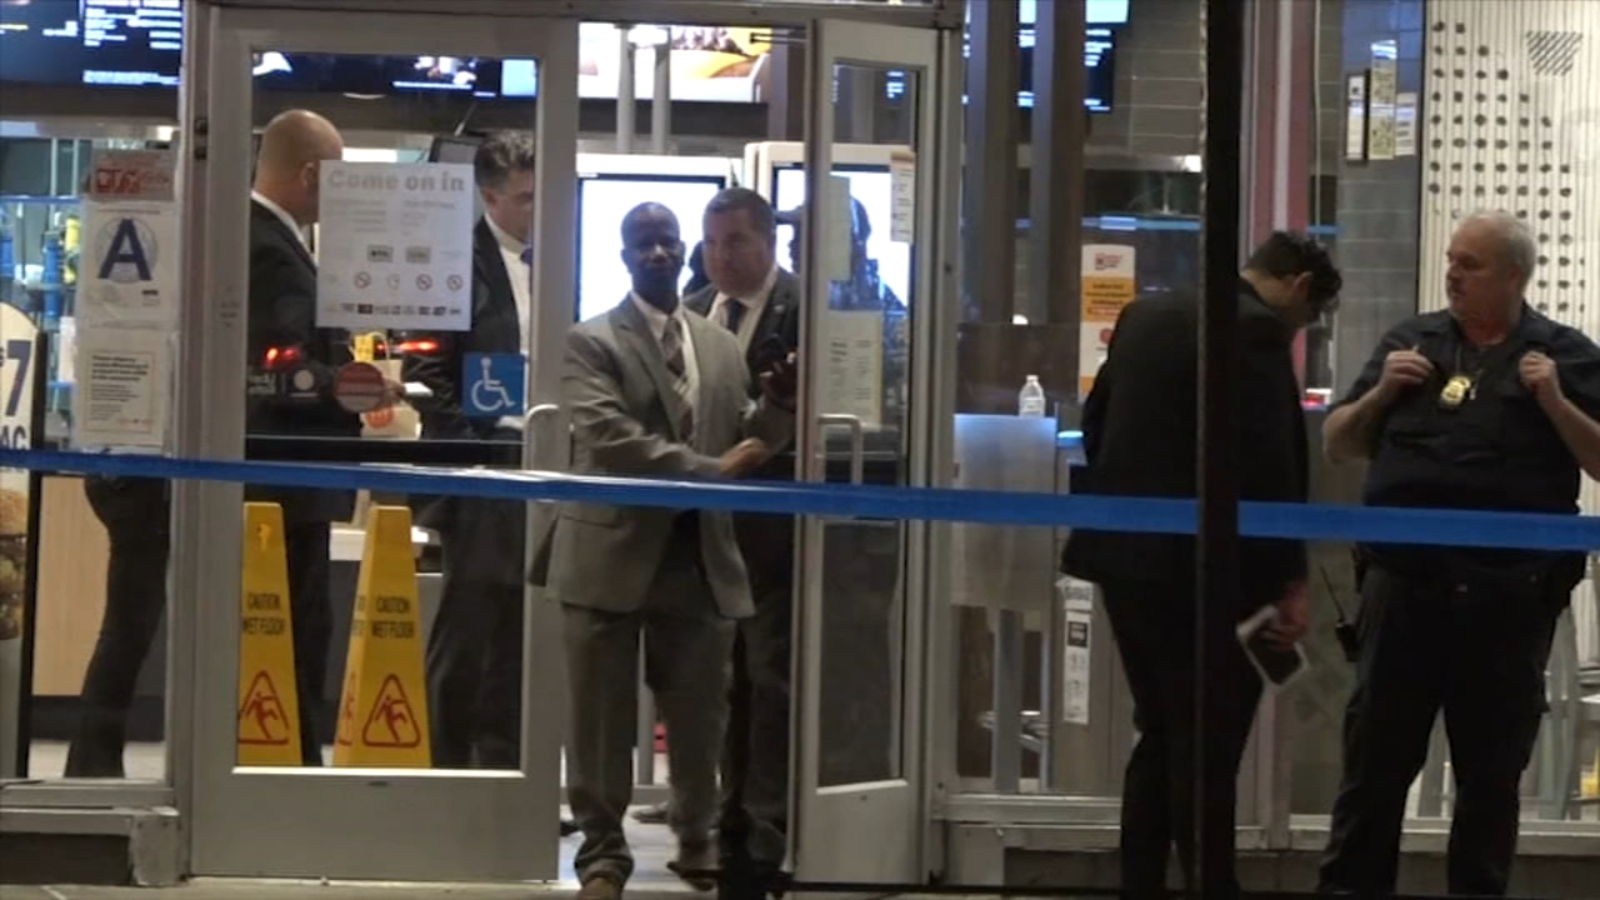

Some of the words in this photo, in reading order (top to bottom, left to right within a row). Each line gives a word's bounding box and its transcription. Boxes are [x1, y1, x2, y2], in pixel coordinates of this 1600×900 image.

[328, 170, 399, 191] Come
[405, 174, 435, 192] on
[441, 171, 465, 192] in
[97, 218, 153, 281] A
[5, 340, 31, 416] 7
[247, 592, 281, 611] CAUTION
[376, 596, 411, 614] CAUTION
[259, 617, 285, 635] FLOOR
[389, 621, 415, 639] FLOOR
